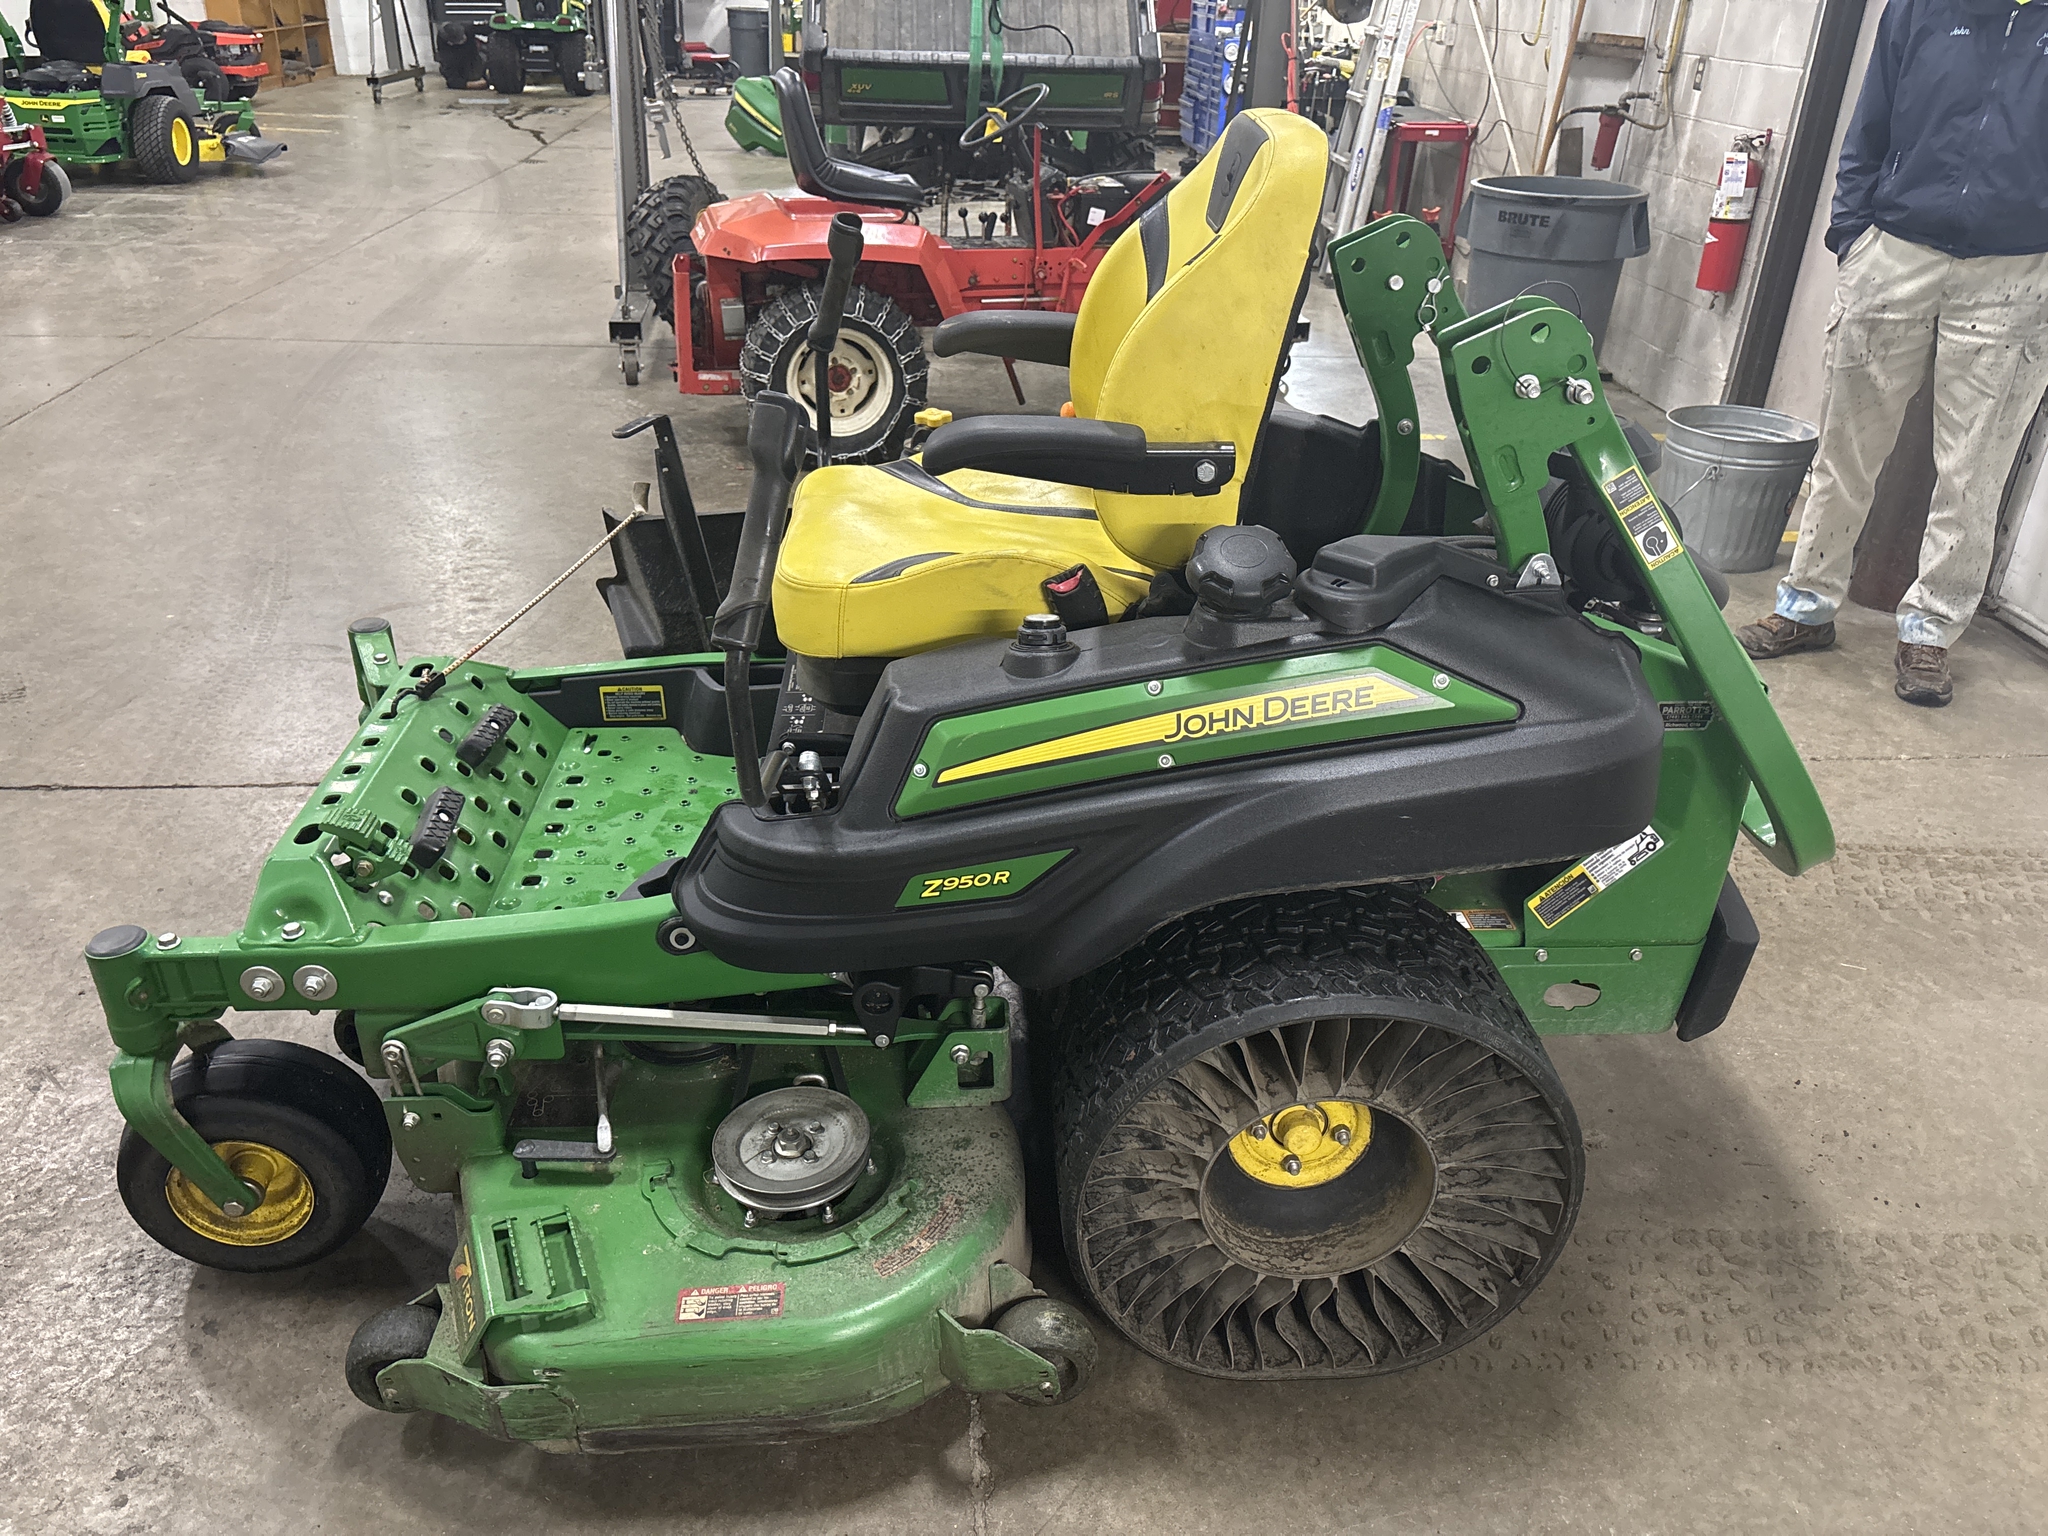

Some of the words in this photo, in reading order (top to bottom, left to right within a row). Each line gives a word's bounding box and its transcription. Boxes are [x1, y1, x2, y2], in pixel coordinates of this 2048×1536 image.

[1950, 26, 1971, 36] John
[1498, 210, 1550, 228] BRUTE
[1651, 551, 1676, 568] CAUTION
[1164, 705, 1254, 740] JOHN
[1263, 685, 1375, 723] DEERE
[1544, 873, 1574, 898] ATENCIÓN
[701, 1287, 729, 1295] DANGER
[748, 1283, 778, 1292] PELIGRO
